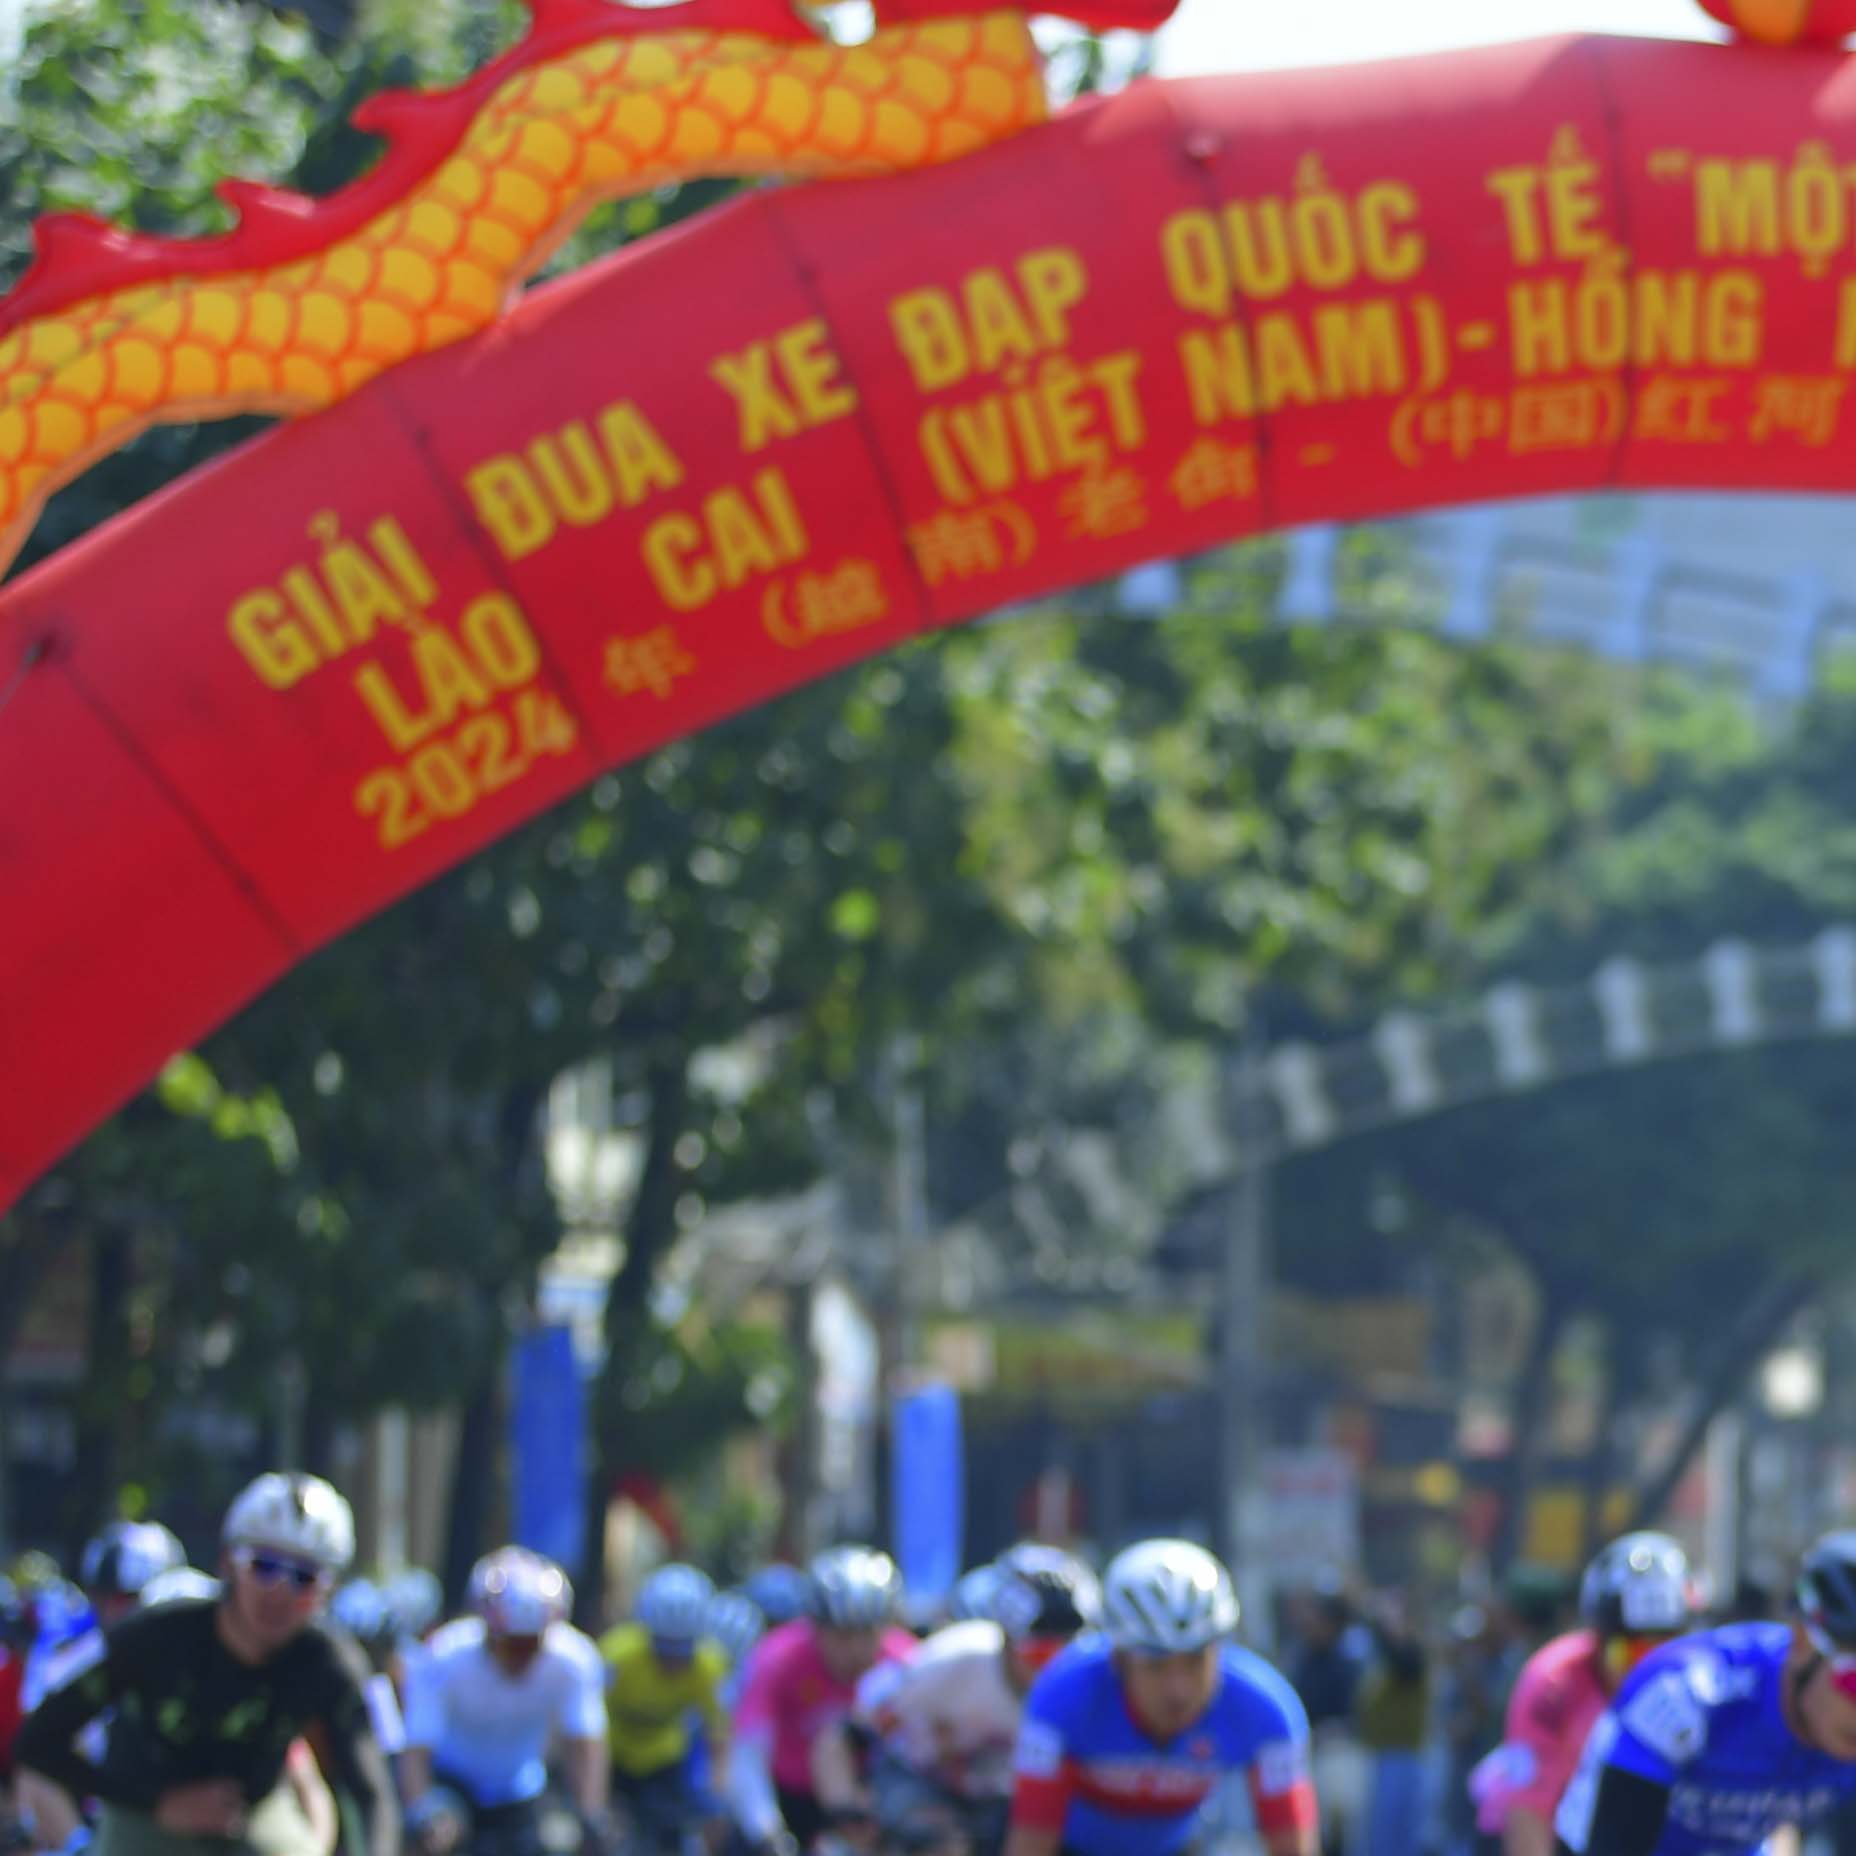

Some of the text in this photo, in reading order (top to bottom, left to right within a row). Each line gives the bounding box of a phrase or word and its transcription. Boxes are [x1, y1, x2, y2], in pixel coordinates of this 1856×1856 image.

[228, 509, 438, 692] GIẢI
[464, 400, 685, 562] ĐUA
[708, 318, 859, 454] XE
[888, 246, 1088, 390] ĐẠP
[1160, 152, 1426, 320] QUỐC
[1485, 124, 1604, 267] TẾ
[354, 591, 541, 753] LÀO
[641, 466, 808, 612] CAI
[917, 350, 1147, 506] (VIỆT
[1507, 234, 1763, 378] HỒNG
